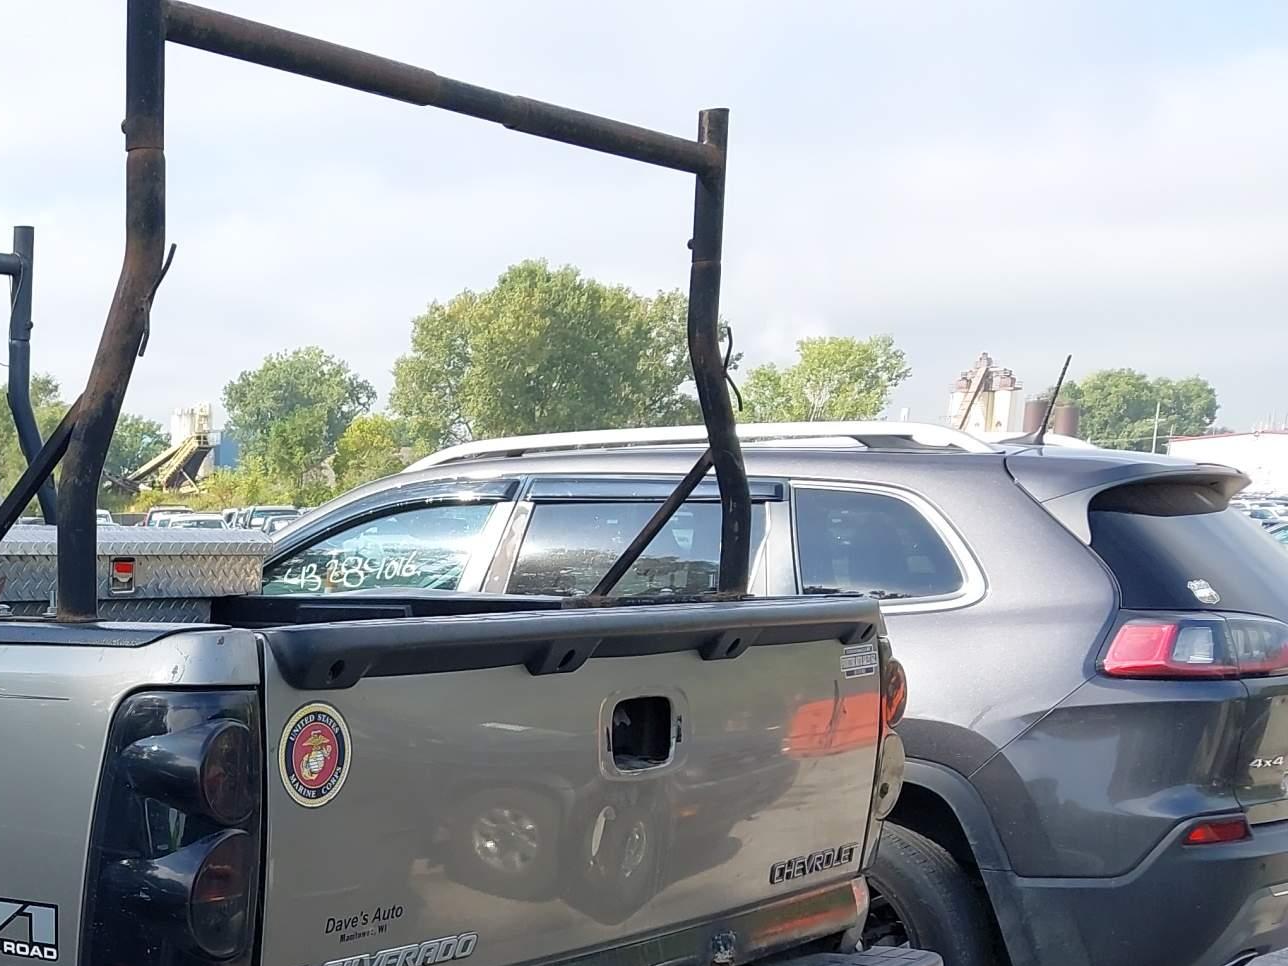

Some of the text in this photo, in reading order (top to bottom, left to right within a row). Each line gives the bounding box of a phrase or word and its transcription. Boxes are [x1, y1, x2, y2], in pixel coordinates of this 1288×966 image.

[289, 713, 340, 742] UNITED STATES
[1248, 755, 1284, 769] 4x4
[289, 766, 342, 798] MARINE CORPS
[769, 841, 860, 885] CHEVROLET
[325, 904, 404, 934] Dave's Auto
[3, 941, 59, 961] ROAD
